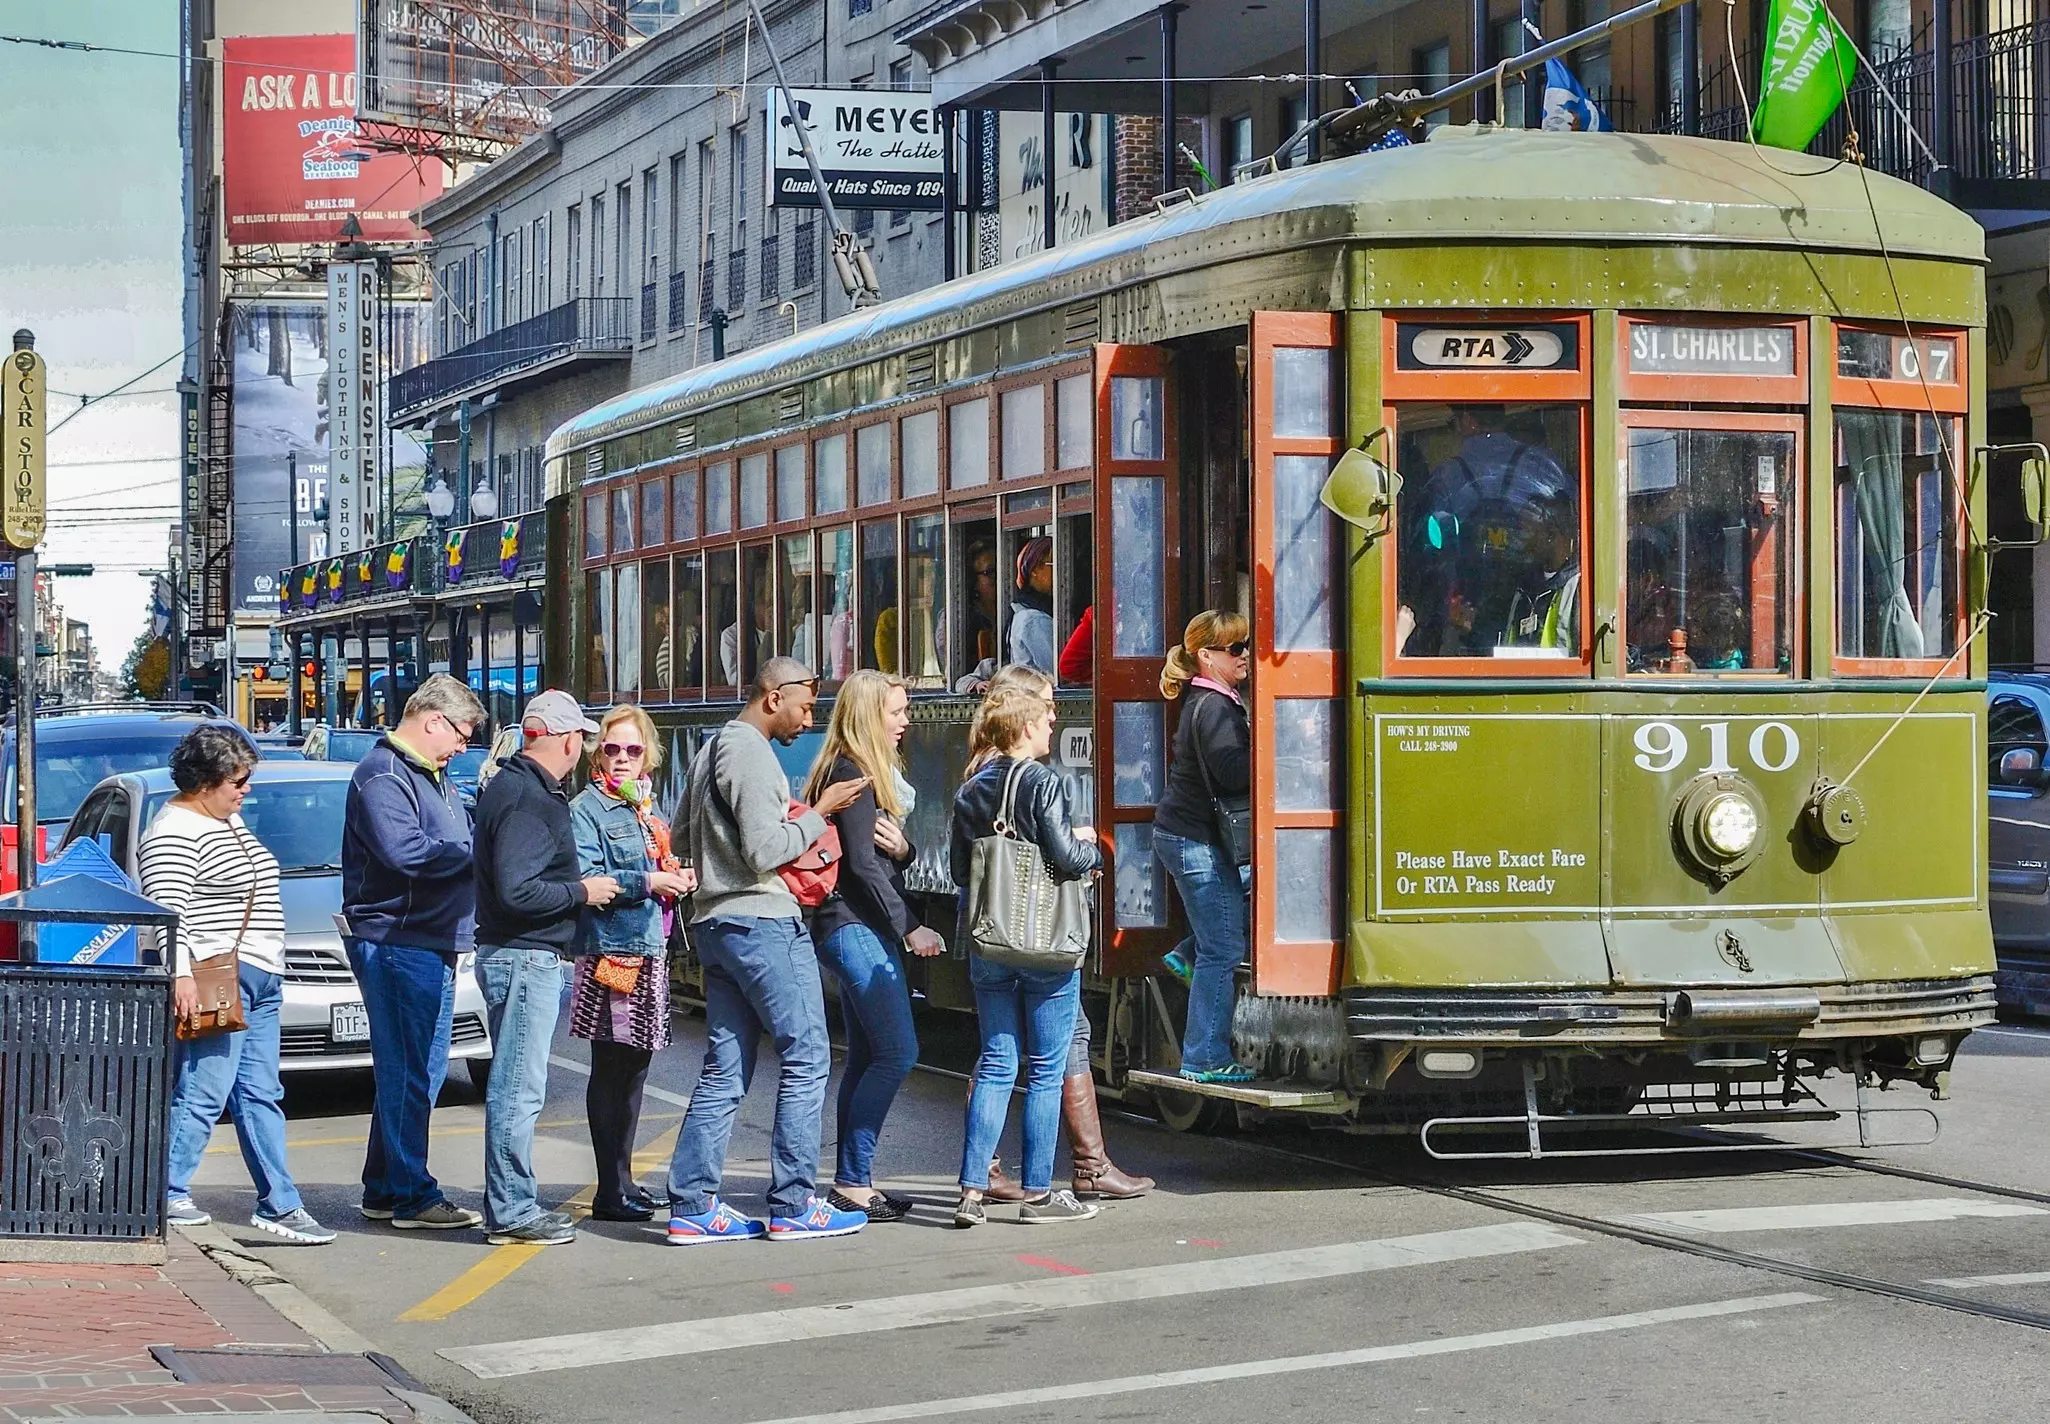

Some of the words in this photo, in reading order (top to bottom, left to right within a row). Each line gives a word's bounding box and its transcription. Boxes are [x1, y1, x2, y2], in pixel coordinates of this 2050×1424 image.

[242, 74, 295, 111] ASK
[302, 74, 321, 109] A
[837, 139, 873, 157] The
[304, 159, 357, 172] Seafood
[781, 177, 833, 193] Qualiy
[833, 179, 868, 194] Hats
[871, 180, 911, 196] Since
[305, 198, 355, 210] DEANIES.COM
[246, 214, 266, 224] BLOCK
[266, 213, 279, 223] OFF
[363, 211, 384, 220] CANAL
[337, 273, 348, 333] MEN'S
[1442, 338, 1495, 358] RTA
[1633, 326, 1666, 360] ST.
[1672, 327, 1781, 363] CHARLES
[18, 378, 34, 428] CAR
[338, 349, 349, 460] CLOTHING
[308, 464, 328, 474] THE
[339, 473, 350, 484] &
[282, 519, 316, 527] FOLOW
[1387, 725, 1414, 737] HOW'S
[1416, 725, 1430, 737] MY
[1433, 725, 1470, 737] DRIVING
[1070, 736, 1088, 758] RTA
[1400, 740, 1422, 752] CALL
[1424, 740, 1458, 752] 248-3900
[1633, 721, 1800, 773] 910
[1395, 851, 1445, 869] Please
[1452, 850, 1491, 868] Have
[1498, 849, 1544, 868] Exact
[1551, 849, 1585, 867] Fare
[1396, 876, 1417, 894] Or
[1424, 875, 1459, 894] RTA
[1466, 875, 1499, 893] Pass
[1506, 874, 1555, 894] Ready
